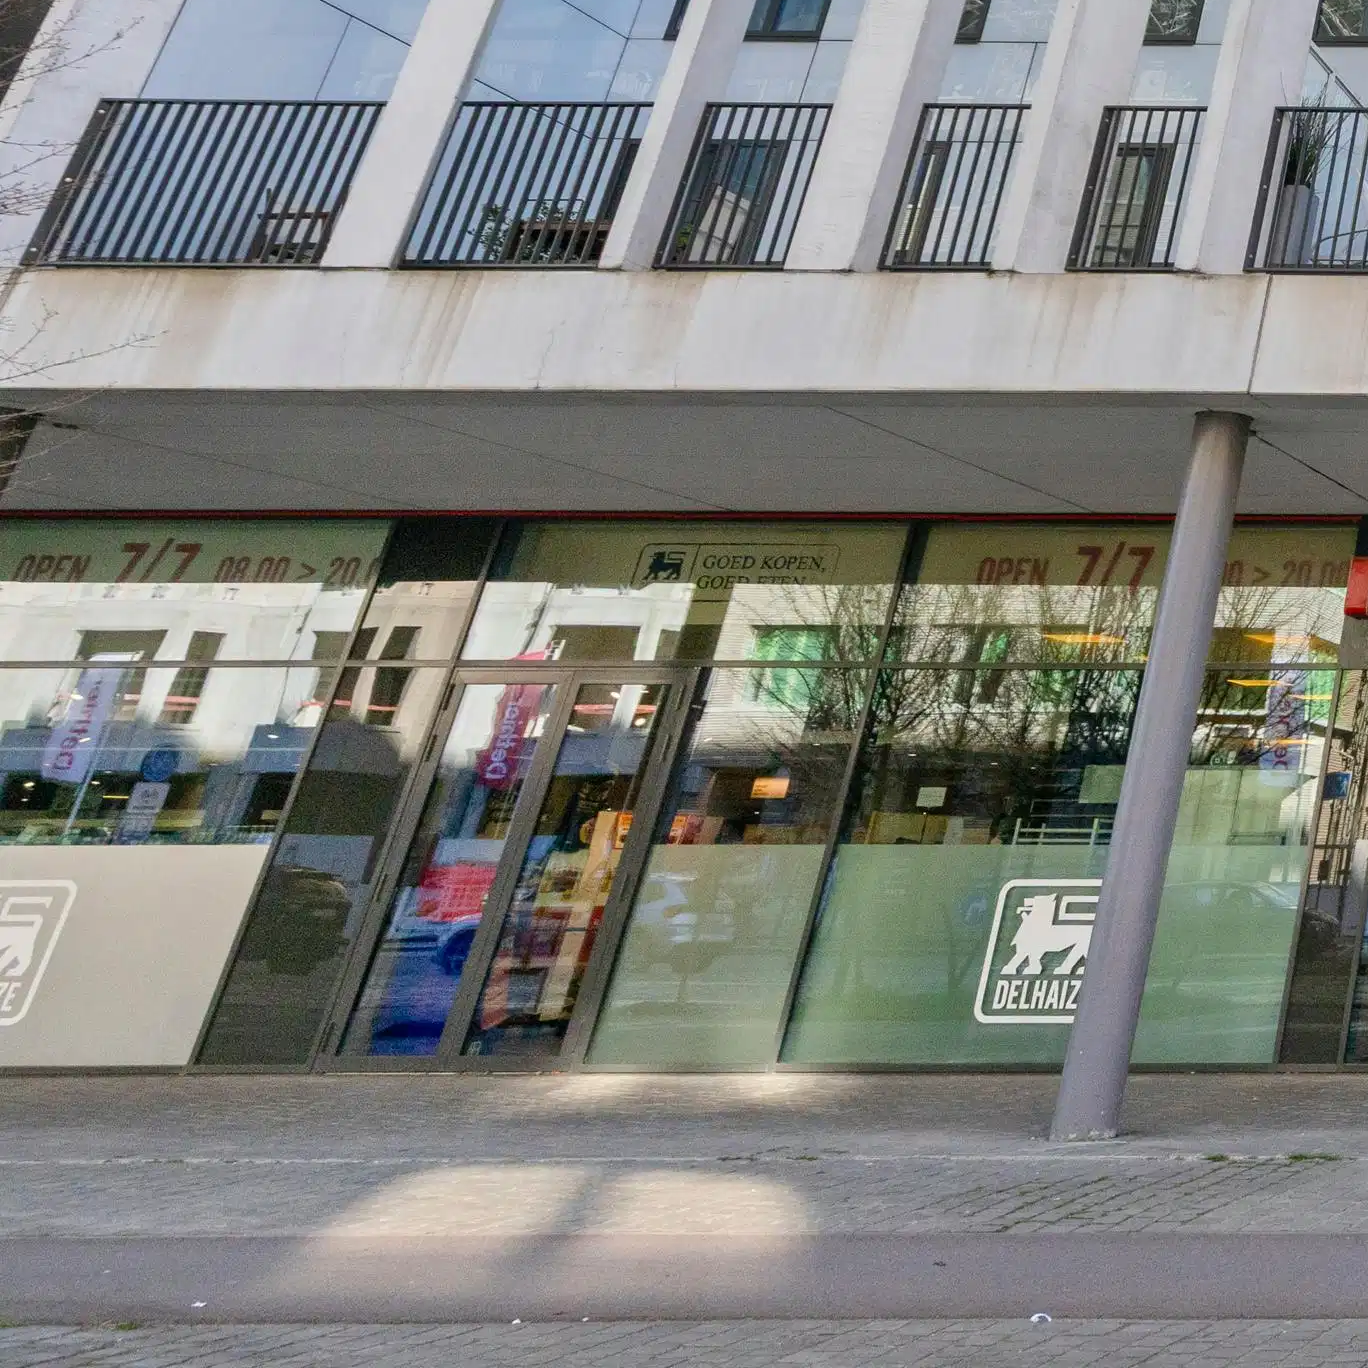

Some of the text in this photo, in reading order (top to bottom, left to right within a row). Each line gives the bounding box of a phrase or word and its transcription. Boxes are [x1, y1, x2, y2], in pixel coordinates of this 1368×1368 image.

[12, 553, 92, 583] OPEN
[114, 538, 203, 583] 7/7
[214, 556, 291, 583] 0800
[702, 554, 827, 573] GOED KOPEN,
[975, 540, 1156, 590] OPEN 7/7
[991, 979, 1083, 1010] DELHAIZ
